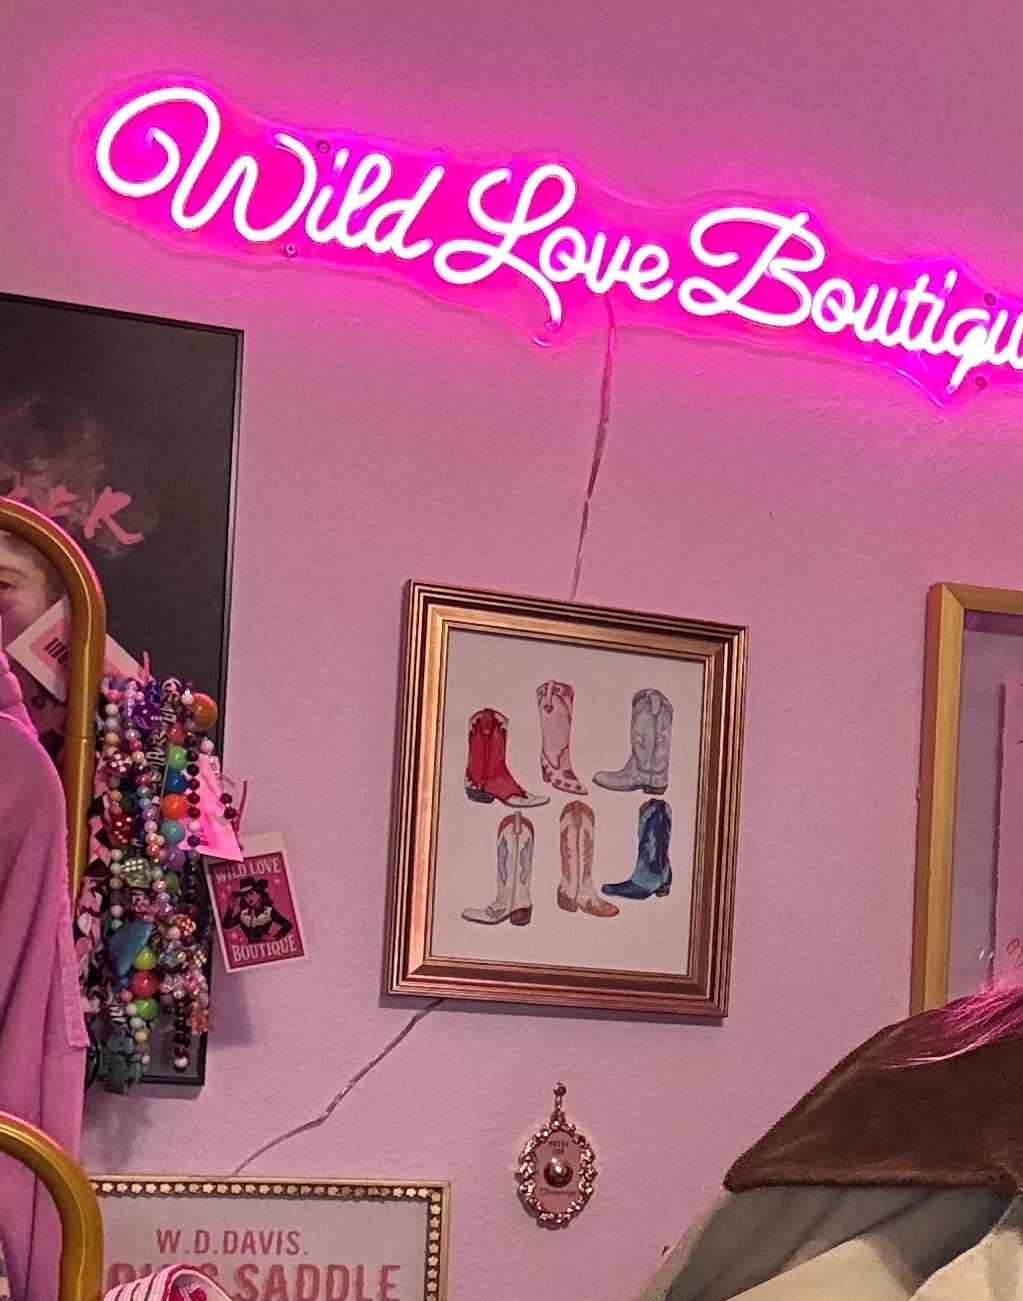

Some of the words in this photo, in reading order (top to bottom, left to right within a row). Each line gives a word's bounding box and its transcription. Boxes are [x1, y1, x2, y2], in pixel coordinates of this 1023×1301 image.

[96, 86, 445, 259] Wild
[434, 163, 675, 330] Love
[215, 860, 248, 882] WILD
[249, 858, 282, 875] LOVE
[231, 934, 298, 962] BOUTIQUE
